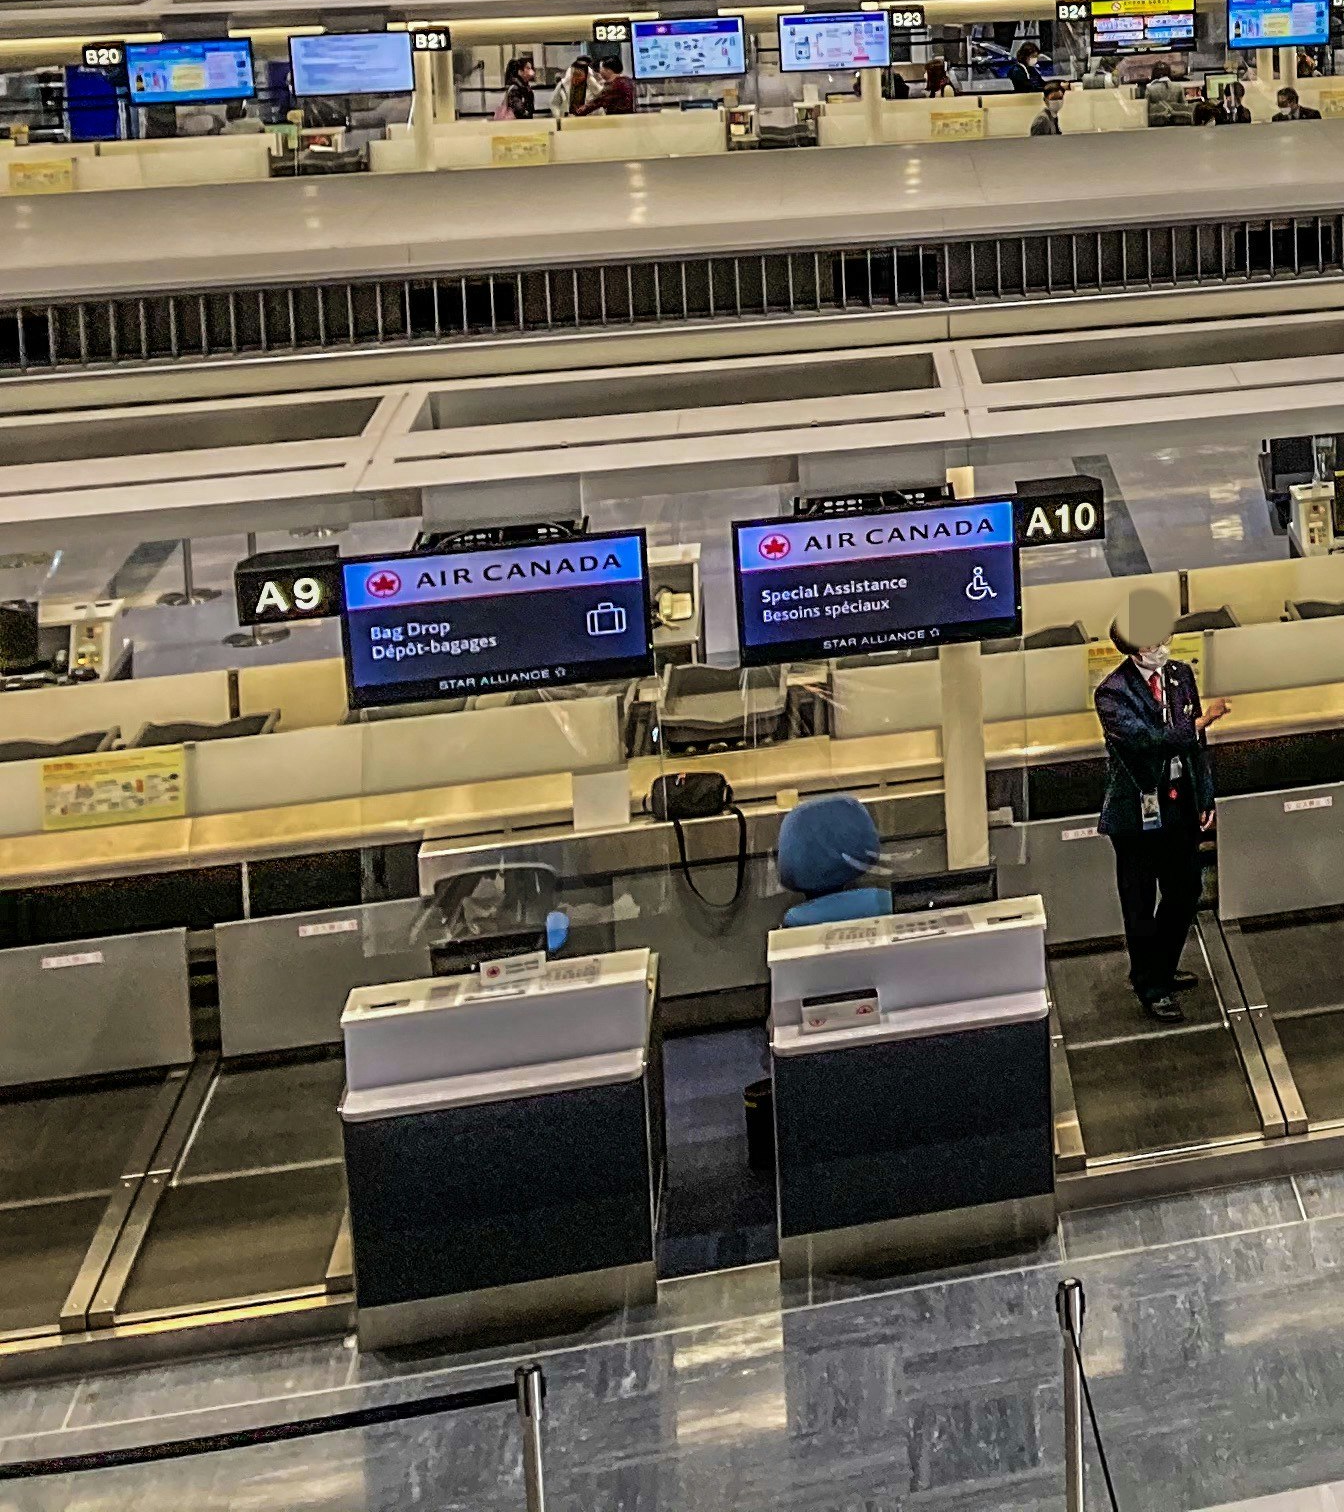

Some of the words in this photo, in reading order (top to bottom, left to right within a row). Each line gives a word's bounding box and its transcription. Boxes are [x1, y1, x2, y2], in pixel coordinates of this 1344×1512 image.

[893, 13, 922, 27] B23
[1059, 5, 1087, 20] B24
[416, 34, 445, 49] B21
[595, 26, 626, 41] B22
[85, 48, 122, 66] B20
[1026, 502, 1096, 538] A10
[803, 531, 856, 553] AIR
[866, 517, 995, 546] CANADA
[416, 567, 474, 590] AIR
[483, 552, 622, 583] CANADA
[255, 576, 322, 615] A9
[761, 583, 819, 605] Special
[823, 575, 908, 597] Assistance
[762, 604, 821, 624] Besoins
[824, 597, 890, 621] spéciaux
[371, 624, 402, 644] Bag
[406, 619, 451, 640] Drop
[823, 638, 858, 650] STAR
[861, 630, 925, 646] ALLIANCE
[371, 634, 498, 662] Dépôt-bagages
[439, 677, 476, 691] STAR
[480, 669, 550, 687] ALLIANCE
